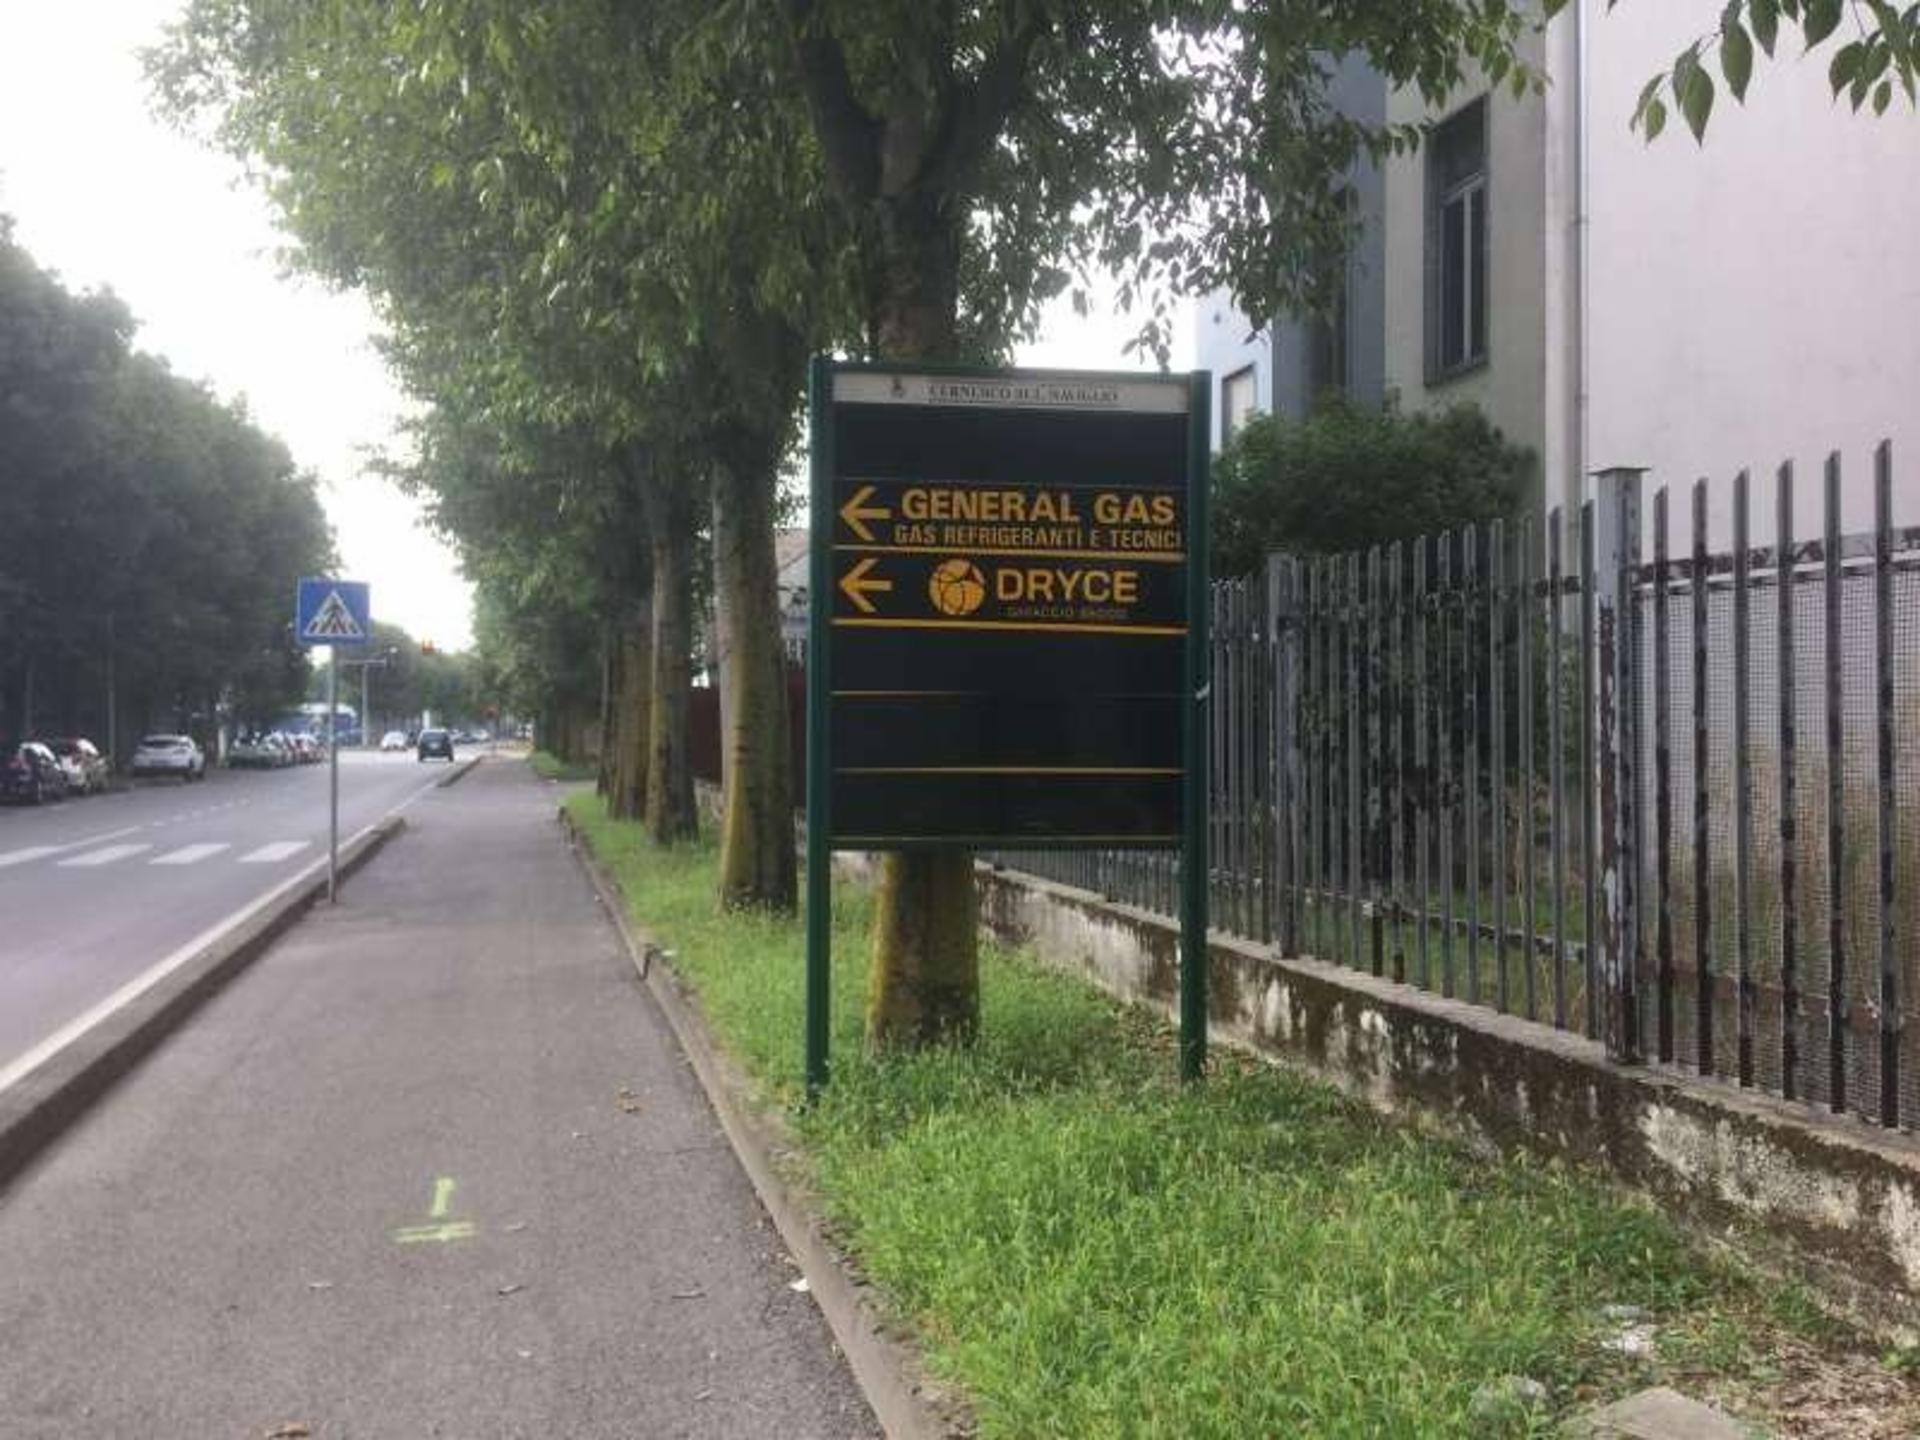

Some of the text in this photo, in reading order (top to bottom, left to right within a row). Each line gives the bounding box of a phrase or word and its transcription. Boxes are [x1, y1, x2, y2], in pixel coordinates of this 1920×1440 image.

[902, 489, 1175, 524] GENERAL GAS
[895, 525, 1181, 548] GAS REFRIGERANTI E TECNICI
[997, 568, 1137, 603] DRYCE
